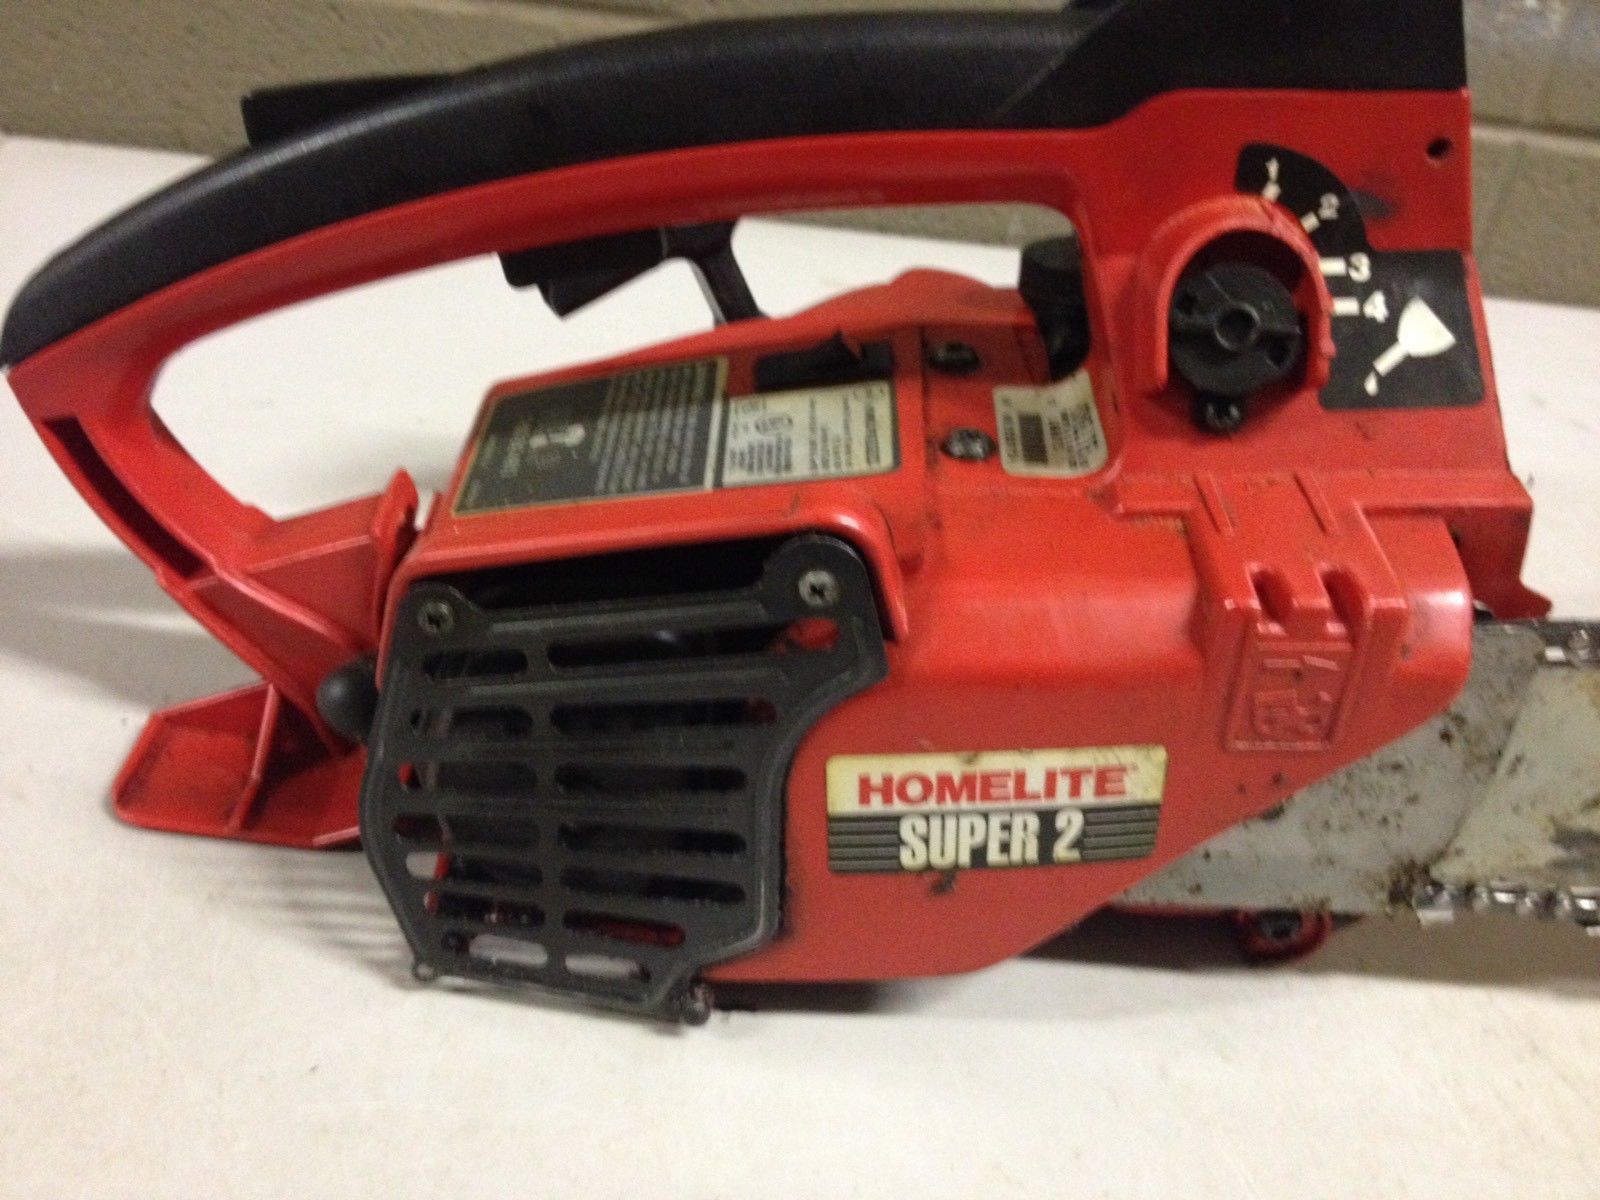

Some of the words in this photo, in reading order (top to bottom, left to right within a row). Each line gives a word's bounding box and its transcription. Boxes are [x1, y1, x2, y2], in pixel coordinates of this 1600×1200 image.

[1318, 193, 1340, 219] 2
[1348, 252, 1371, 282] 3
[1363, 290, 1389, 322] 4
[858, 766, 1128, 805] HOMELITE
[899, 809, 1040, 871] SUPER
[1052, 807, 1085, 864] 2
